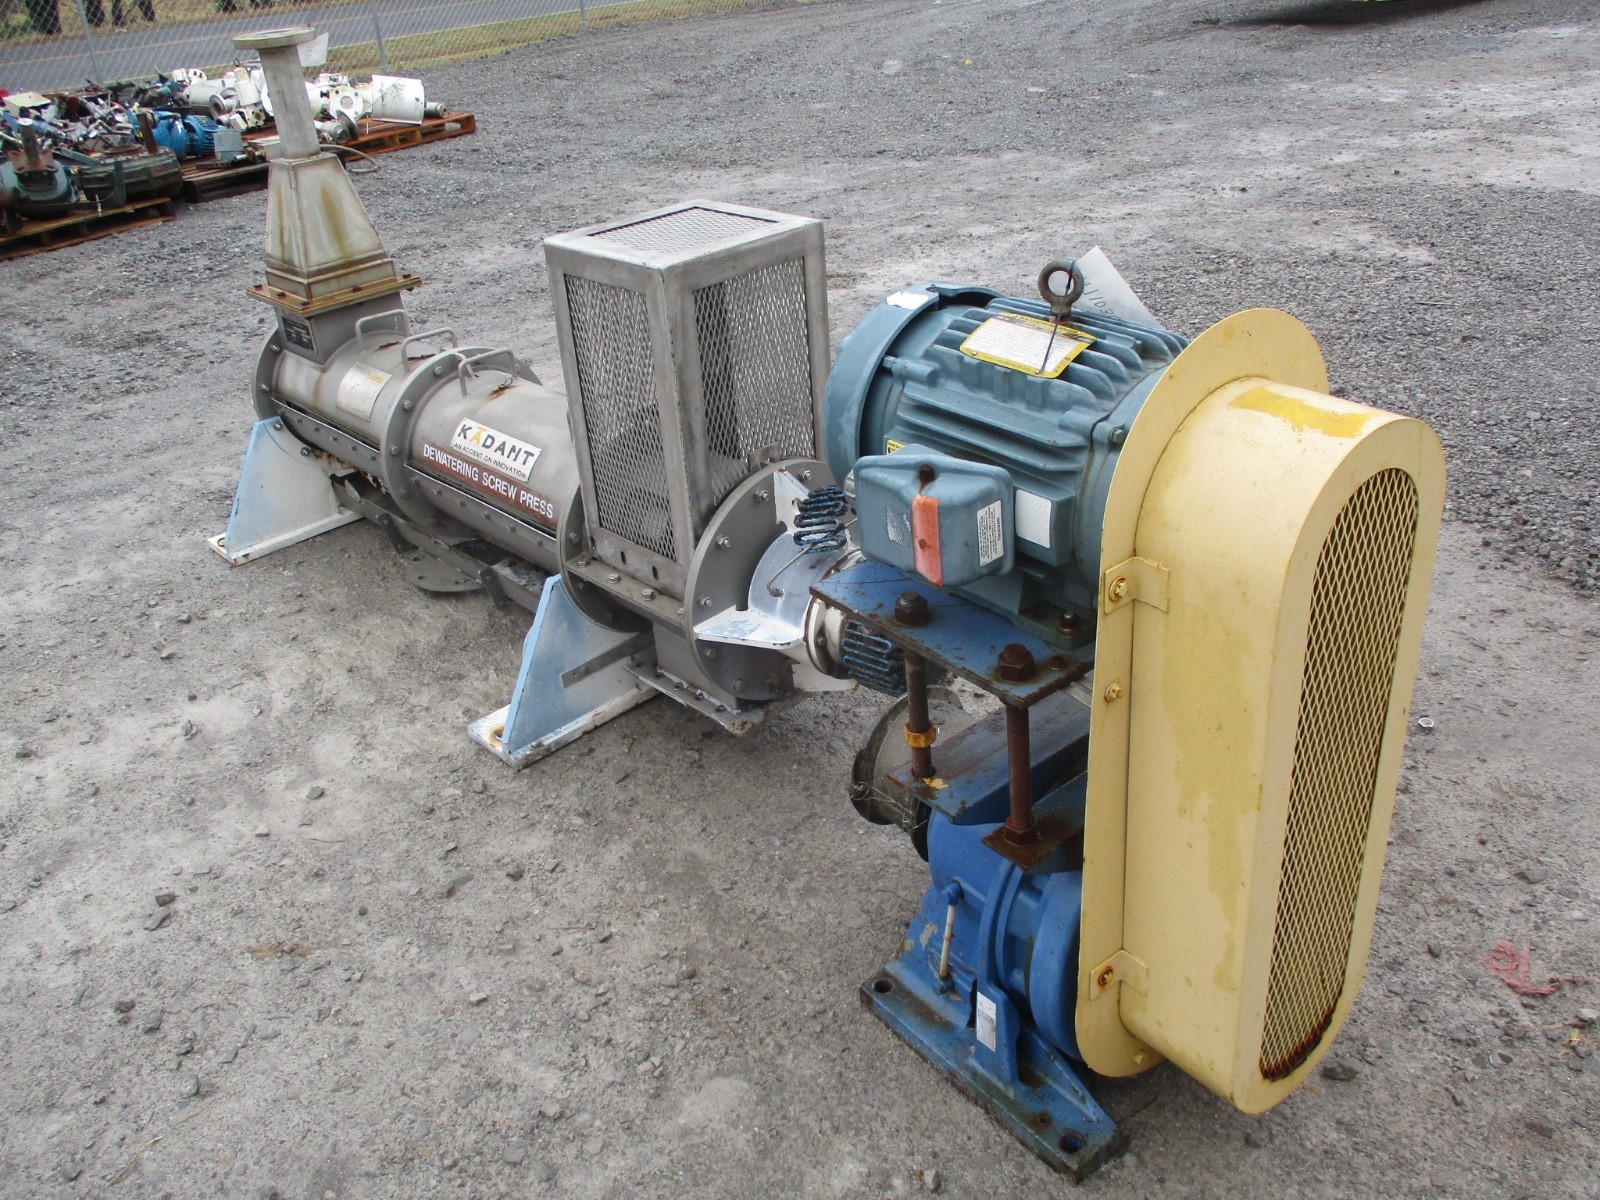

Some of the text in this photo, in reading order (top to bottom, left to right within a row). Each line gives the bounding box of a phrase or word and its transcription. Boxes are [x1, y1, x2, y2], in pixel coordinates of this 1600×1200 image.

[423, 443, 554, 519] DEWATERING SCREW PRESS
[454, 442, 462, 450] AN
[462, 446, 483, 459] ACCENT
[493, 459, 527, 478] INNOVATION
